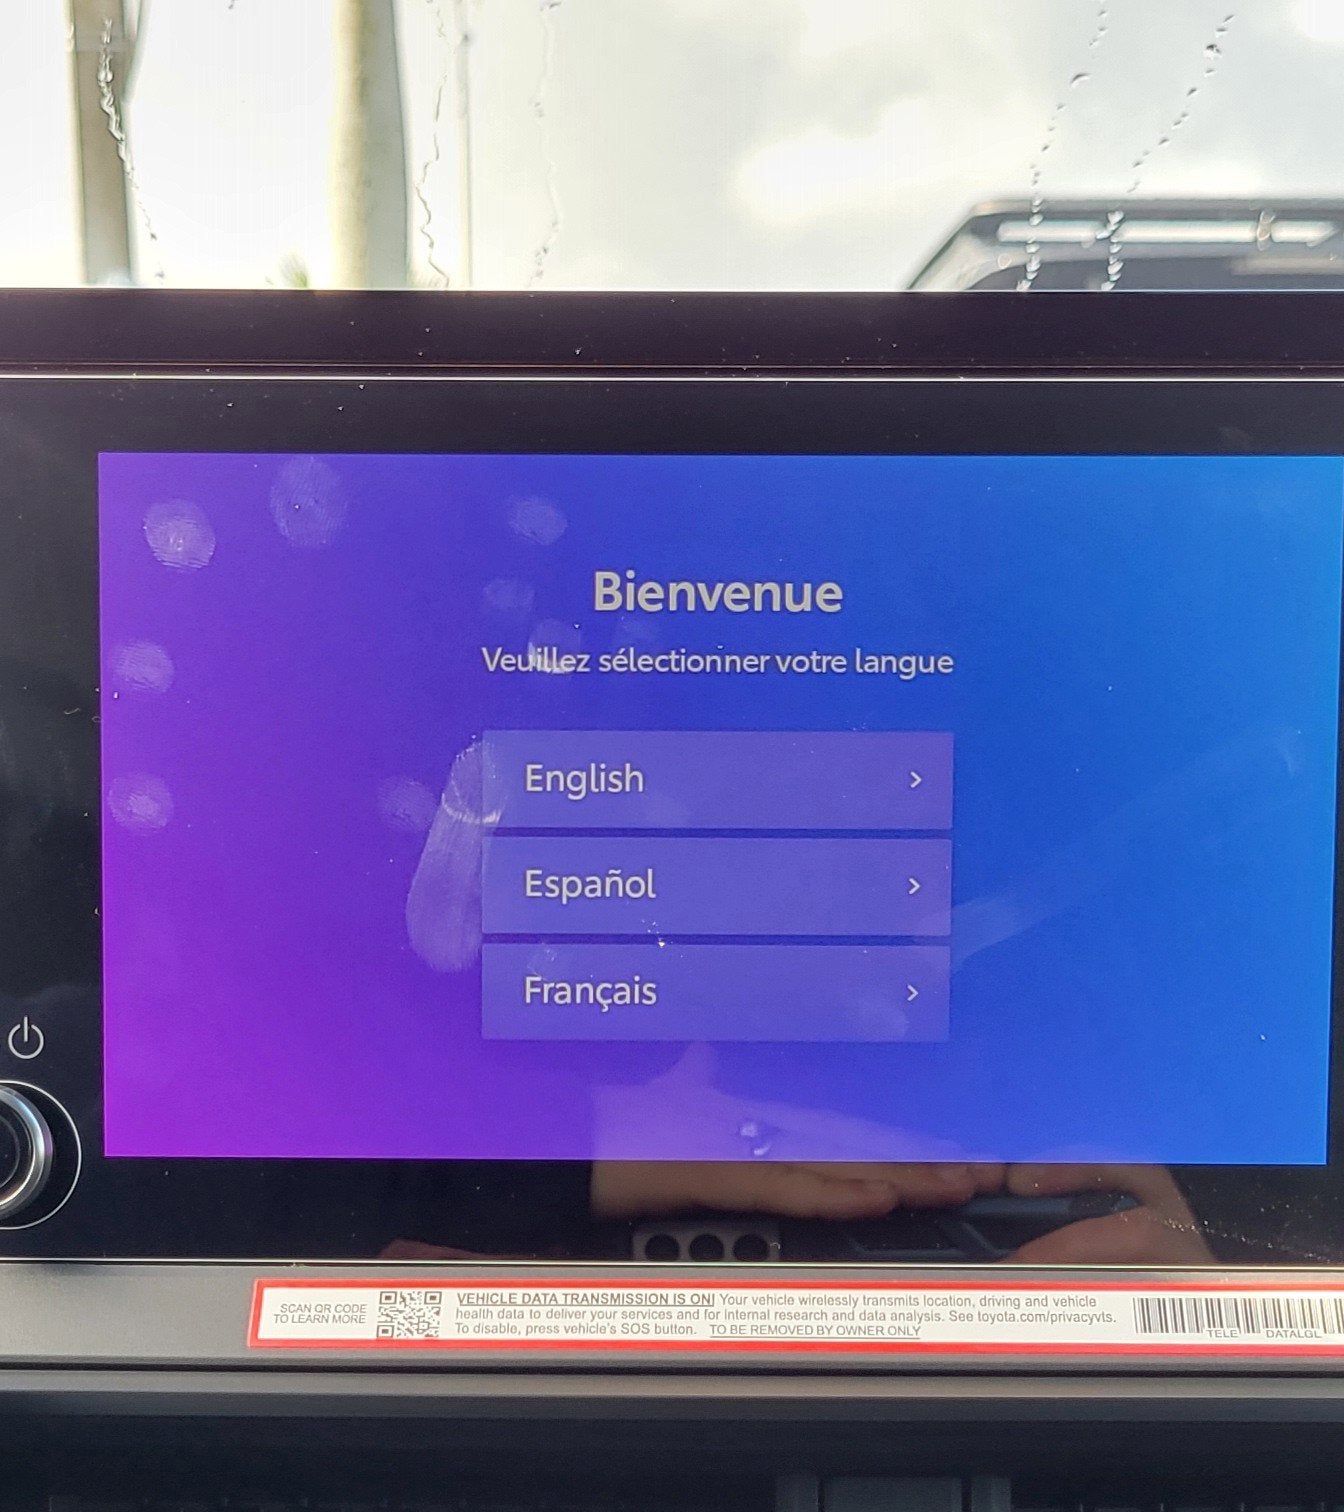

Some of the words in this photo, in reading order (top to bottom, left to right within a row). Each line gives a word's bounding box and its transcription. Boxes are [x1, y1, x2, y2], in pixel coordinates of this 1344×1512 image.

[593, 569, 844, 614] Bienvenue
[481, 646, 591, 674] Veuillez
[599, 646, 770, 675] sélectionner
[775, 650, 847, 675] votre
[855, 647, 955, 681] langue
[525, 762, 645, 801] English
[525, 868, 657, 905] Español
[524, 975, 658, 1013] Français
[280, 1303, 312, 1314] SCAN
[314, 1303, 331, 1314] QR
[334, 1303, 367, 1314] CODE
[457, 1292, 518, 1306] VEHICLE
[522, 1292, 558, 1306] DATA
[561, 1292, 669, 1306] TRANSMISSION
[673, 1293, 686, 1306] IS
[719, 1293, 748, 1306] Your
[752, 1293, 795, 1306] vehicle
[799, 1294, 858, 1309] wirelessly
[862, 1295, 920, 1308] transmits
[923, 1295, 976, 1309] location,
[979, 1295, 1021, 1310] driving
[1025, 1295, 1048, 1308] and
[1052, 1295, 1097, 1308] vehicle
[273, 1314, 289, 1324] TO
[291, 1314, 329, 1325] LEARN
[332, 1314, 367, 1325] MORE
[456, 1307, 493, 1320] health
[497, 1308, 525, 1320] data
[529, 1309, 541, 1320] to
[546, 1308, 586, 1320] deliver
[590, 1310, 618, 1322] your
[621, 1310, 673, 1320] services
[676, 1309, 700, 1320] and
[705, 1309, 721, 1321] for
[724, 1309, 770, 1321] internal
[774, 1309, 828, 1321] research
[832, 1309, 855, 1321] and
[859, 1310, 887, 1322] data
[890, 1310, 945, 1325] analysis.
[948, 1310, 974, 1323] See
[455, 1322, 470, 1334] To
[473, 1322, 522, 1336] disable,
[525, 1324, 560, 1337] press
[564, 1323, 617, 1334] vehicle's
[620, 1323, 651, 1335] SOS
[654, 1324, 697, 1336] button.
[710, 1325, 727, 1336] TO
[730, 1325, 747, 1336] BE
[750, 1325, 814, 1336] REMOVED
[816, 1325, 834, 1337] BY
[836, 1325, 885, 1337] OWNER
[887, 1325, 922, 1337] ONLY
[1207, 1329, 1238, 1339] TELE
